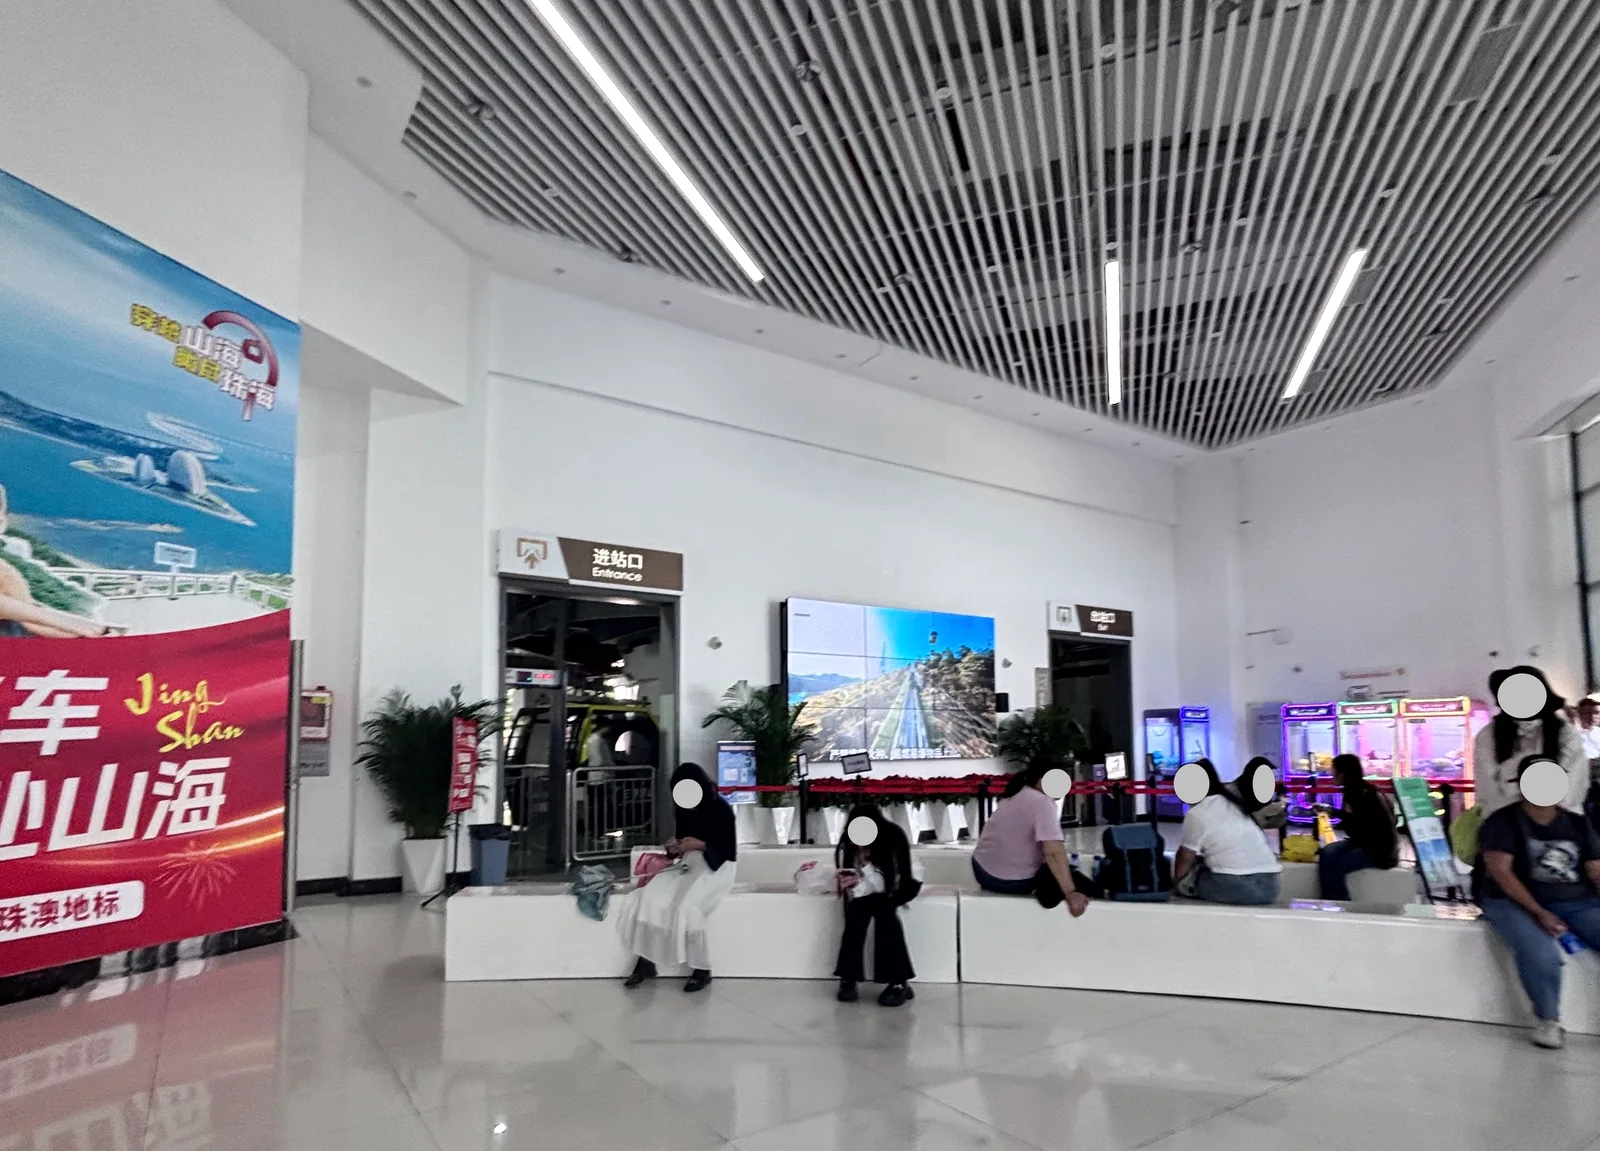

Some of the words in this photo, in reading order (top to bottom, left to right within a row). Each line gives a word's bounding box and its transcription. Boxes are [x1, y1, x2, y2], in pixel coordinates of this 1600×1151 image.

[592, 547, 643, 571] 进站口
[592, 567, 643, 582] Entrance
[0, 669, 109, 756] 车
[124, 672, 227, 714] Jing
[156, 702, 244, 754] Shan
